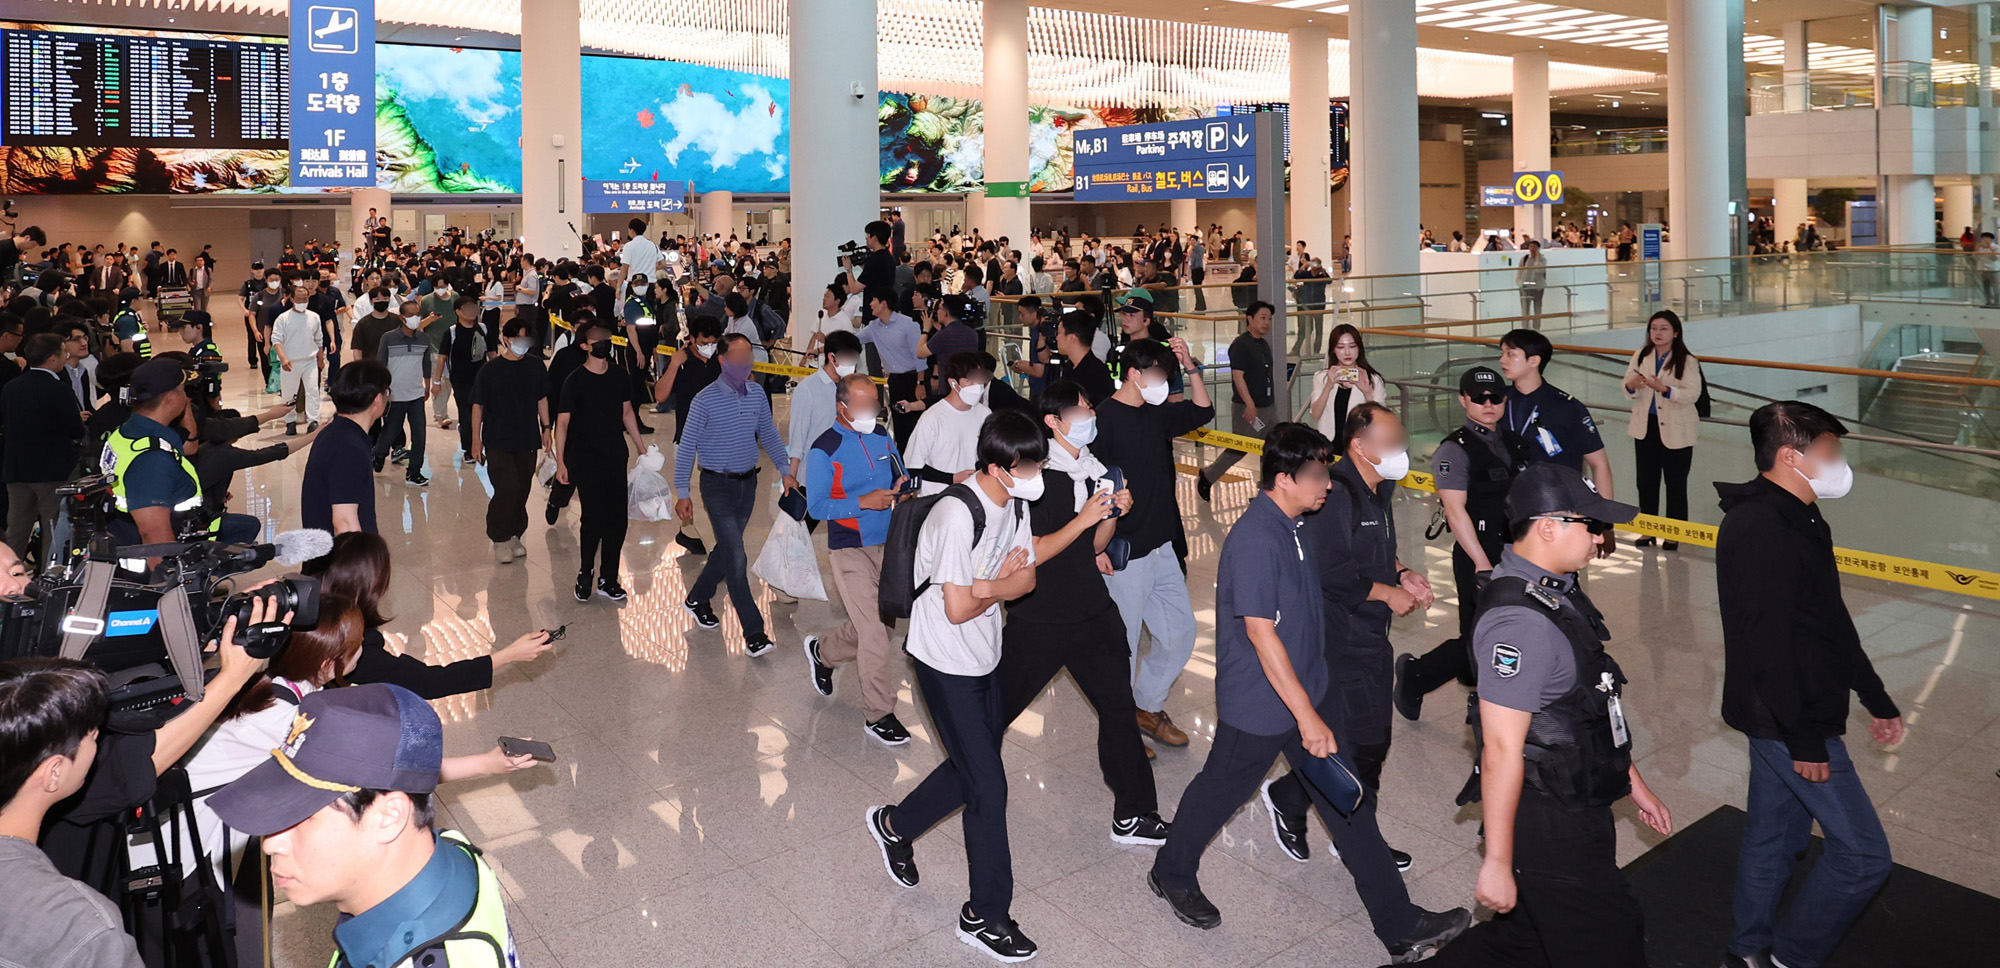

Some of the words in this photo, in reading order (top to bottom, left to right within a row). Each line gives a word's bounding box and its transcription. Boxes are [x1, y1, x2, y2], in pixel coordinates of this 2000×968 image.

[319, 72, 349, 92] 1층
[306, 93, 360, 114] 도착층
[324, 129, 346, 147] 1F
[1167, 130, 1204, 150] 주차장
[1136, 144, 1165, 156] Parking
[299, 165, 343, 178] Arrivals
[346, 165, 368, 178] Hall
[1075, 175, 1089, 190] B1
[1141, 184, 1152, 192] Bus
[611, 200, 618, 208] A
[647, 200, 660, 209] 도착
[1639, 520, 1680, 535] 인천국제공항
[1685, 529, 1714, 541] 보안통제
[1835, 555, 1886, 572] 인천국제공항
[1893, 565, 1929, 580] 보안통제
[111, 618, 142, 627] Channel
